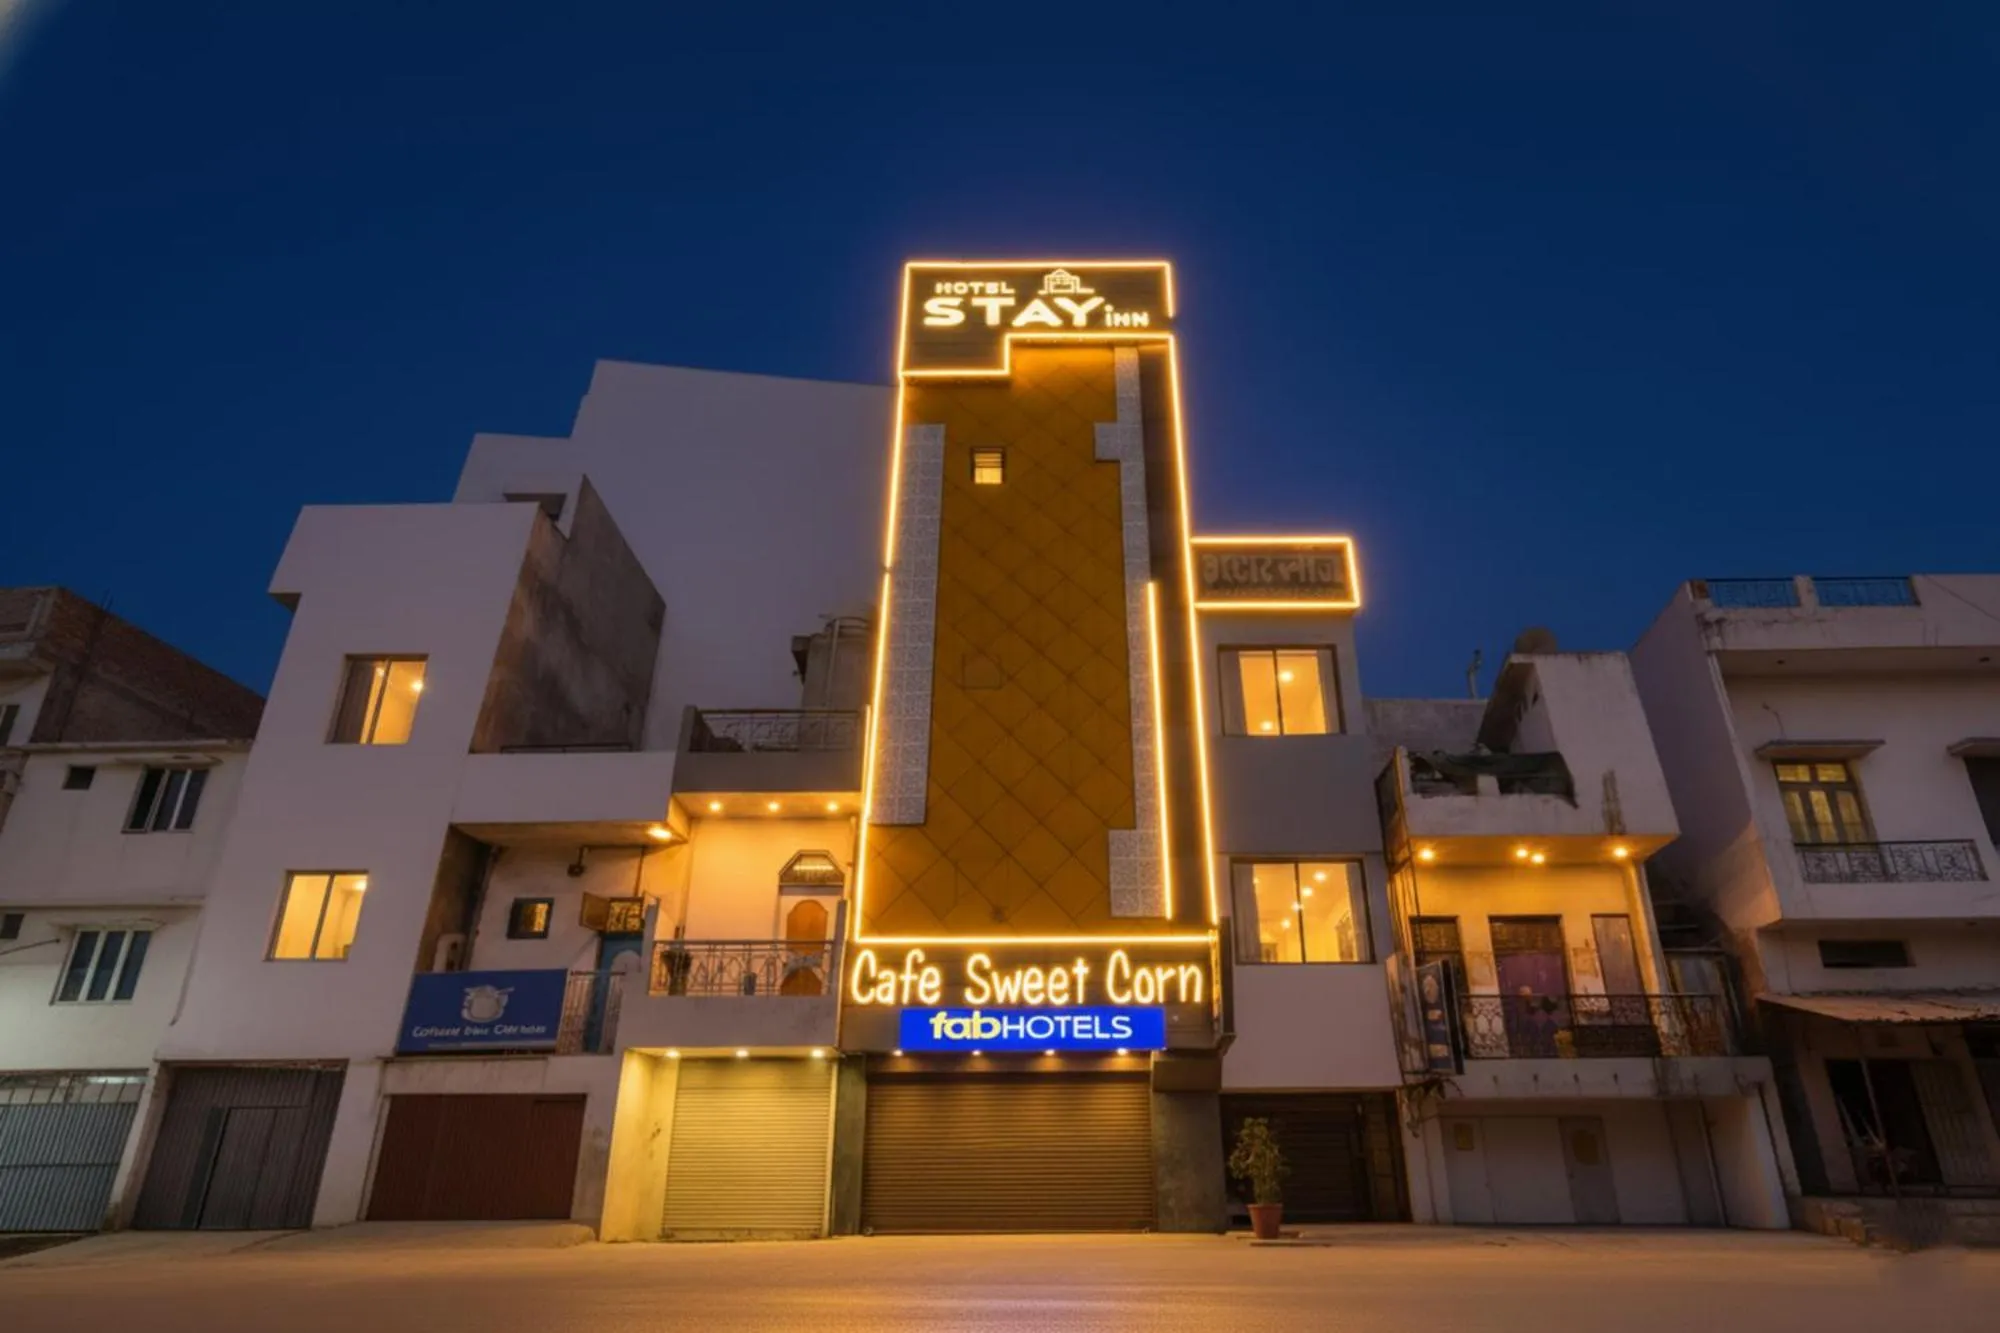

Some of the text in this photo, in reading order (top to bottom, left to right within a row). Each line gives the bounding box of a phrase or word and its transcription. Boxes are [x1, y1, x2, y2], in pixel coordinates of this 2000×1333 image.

[935, 281, 1015, 295] HOTEL
[923, 296, 1105, 327] STAY
[851, 948, 1203, 1005] Cafe Sweet Corn
[929, 1010, 1133, 1040] fabHOTELS
